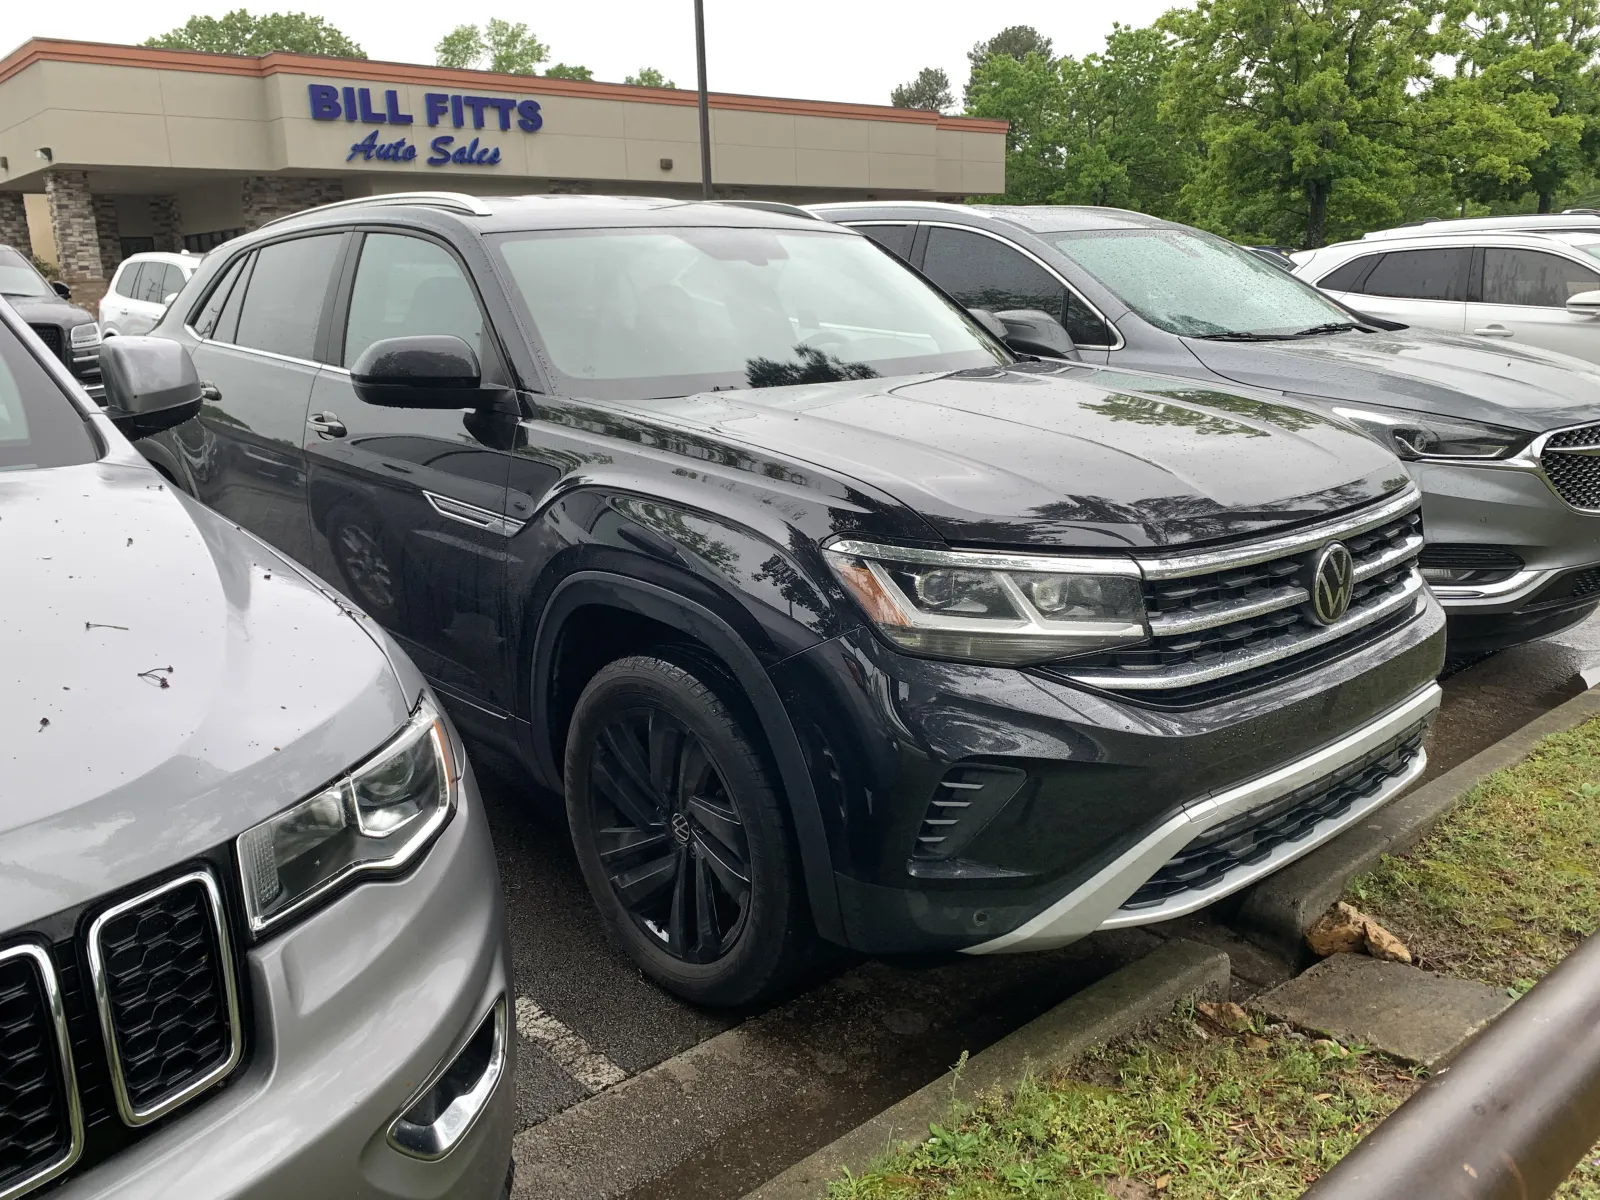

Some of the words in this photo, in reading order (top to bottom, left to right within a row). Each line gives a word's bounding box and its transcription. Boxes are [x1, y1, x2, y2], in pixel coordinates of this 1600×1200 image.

[308, 84, 413, 124] BILL
[425, 93, 543, 132] FITTS
[346, 130, 417, 161] Auto
[427, 136, 502, 165] Sales
